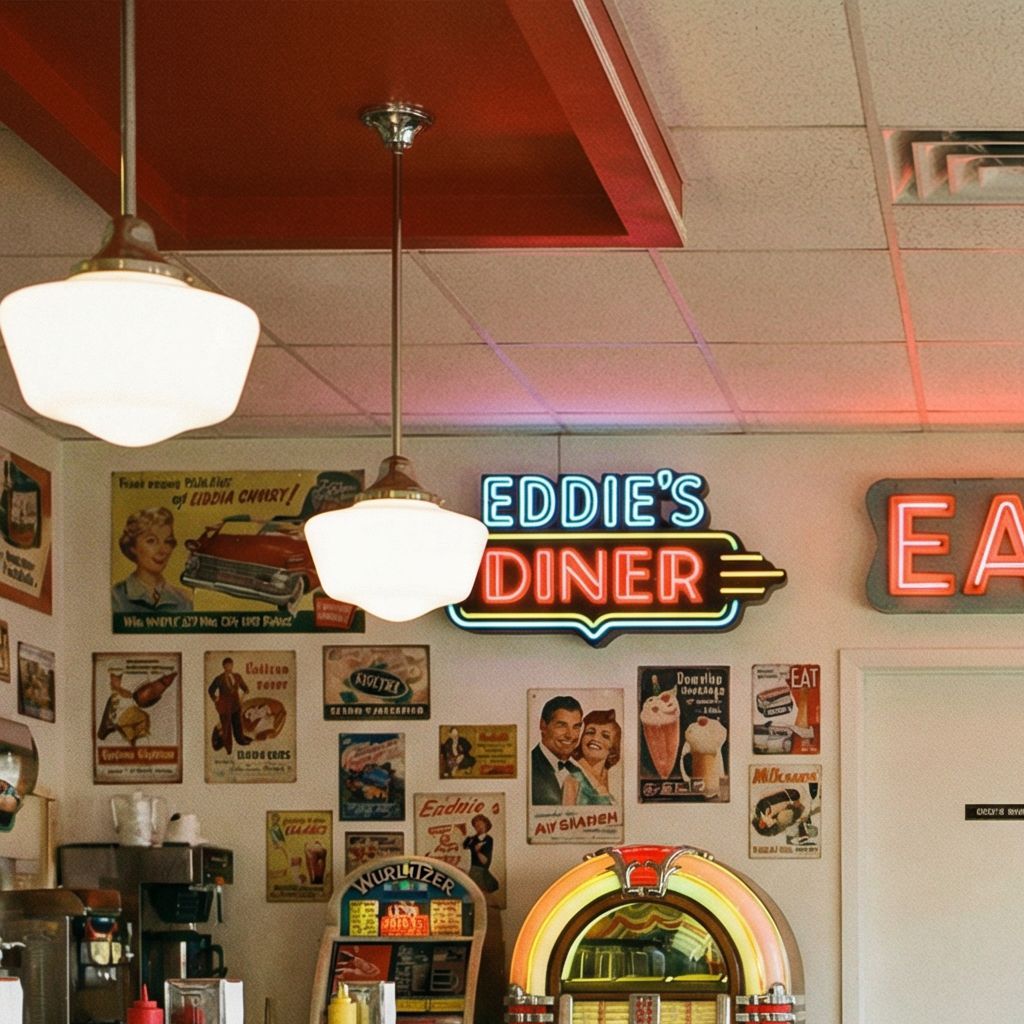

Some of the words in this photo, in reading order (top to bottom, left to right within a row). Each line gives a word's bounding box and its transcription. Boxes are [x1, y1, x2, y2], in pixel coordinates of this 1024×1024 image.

[482, 469, 705, 529] EDDIE'S
[482, 547, 704, 604] DINER
[791, 667, 820, 689] EAT
